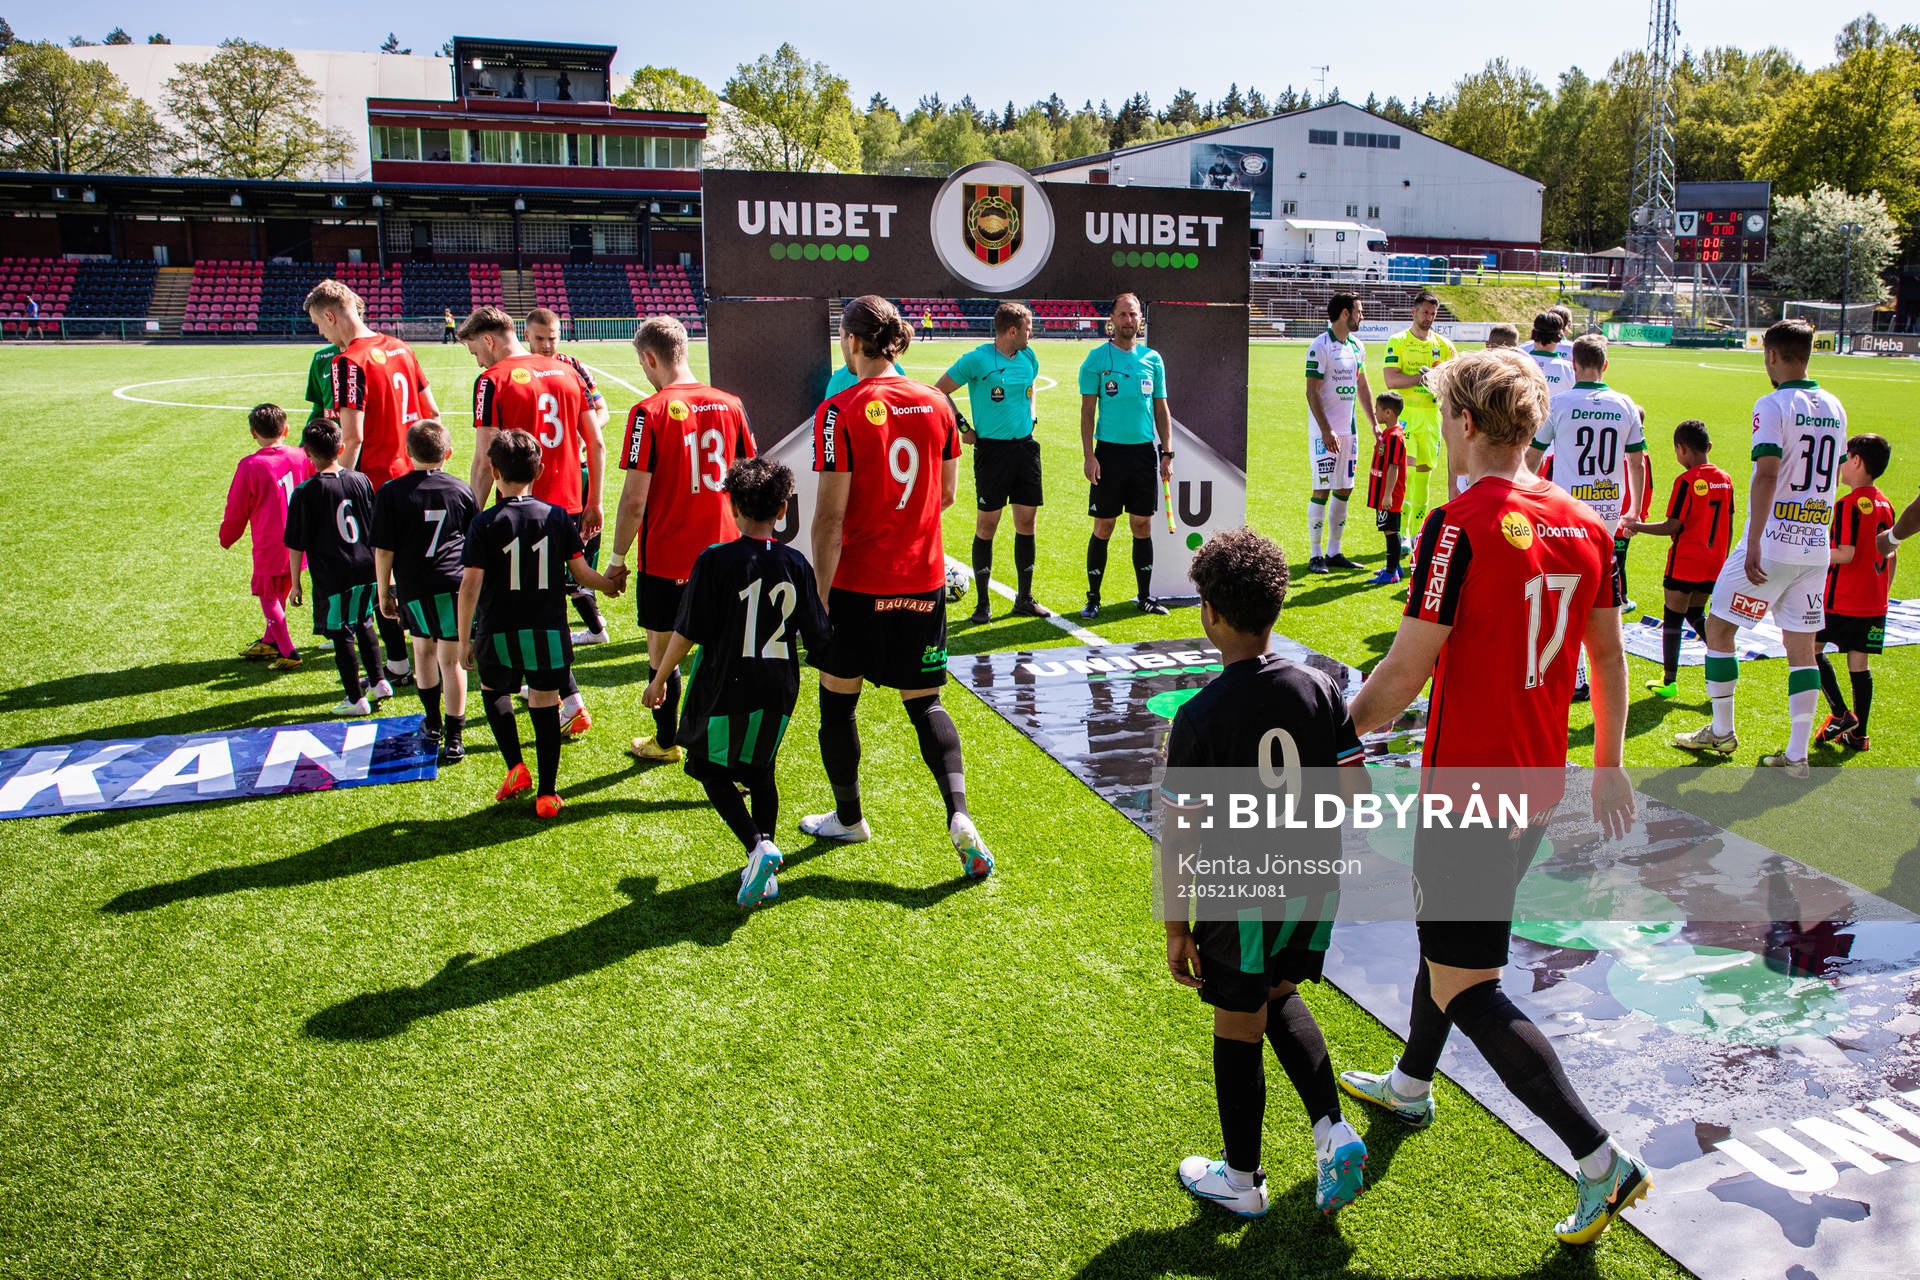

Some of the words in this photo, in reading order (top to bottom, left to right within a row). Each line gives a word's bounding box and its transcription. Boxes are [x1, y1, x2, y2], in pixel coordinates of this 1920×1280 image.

[334, 195, 345, 206] K
[738, 200, 898, 238] UNIBET
[1085, 211, 1224, 247] UNIBET
[1625, 328, 1667, 339] NORTEAM
[1873, 338, 1904, 351] Heba
[347, 365, 357, 404] stadium
[393, 372, 419, 424] 2
[476, 378, 488, 420] stadium
[538, 393, 565, 448] 3
[867, 406, 886, 418] Yale
[891, 405, 933, 416] Doorman
[1571, 409, 1622, 421] Derome
[1796, 413, 1840, 429] Derome
[630, 416, 645, 464] stadium
[823, 409, 838, 463] stadium
[1575, 426, 1617, 476] 20
[683, 429, 728, 494] 13
[889, 437, 919, 510] 9
[1790, 434, 1836, 493] 39
[336, 499, 360, 544] 6
[1179, 481, 1212, 528] U
[1708, 500, 1721, 548] 7
[1774, 502, 1831, 525] Ullared
[424, 509, 447, 558] 7
[1505, 522, 1531, 538] Yale
[1536, 523, 1589, 539] Doorman
[1765, 528, 1826, 547] WELLNES
[1779, 522, 1824, 537] NORDIC
[502, 535, 548, 590] 11
[1424, 523, 1461, 613] stadium
[739, 578, 797, 659] 12
[876, 598, 936, 613] BAUHAUS
[1733, 594, 1767, 614] FMP
[1807, 593, 1823, 609] VS
[1525, 573, 1582, 690] 17
[1258, 728, 1302, 827] 9
